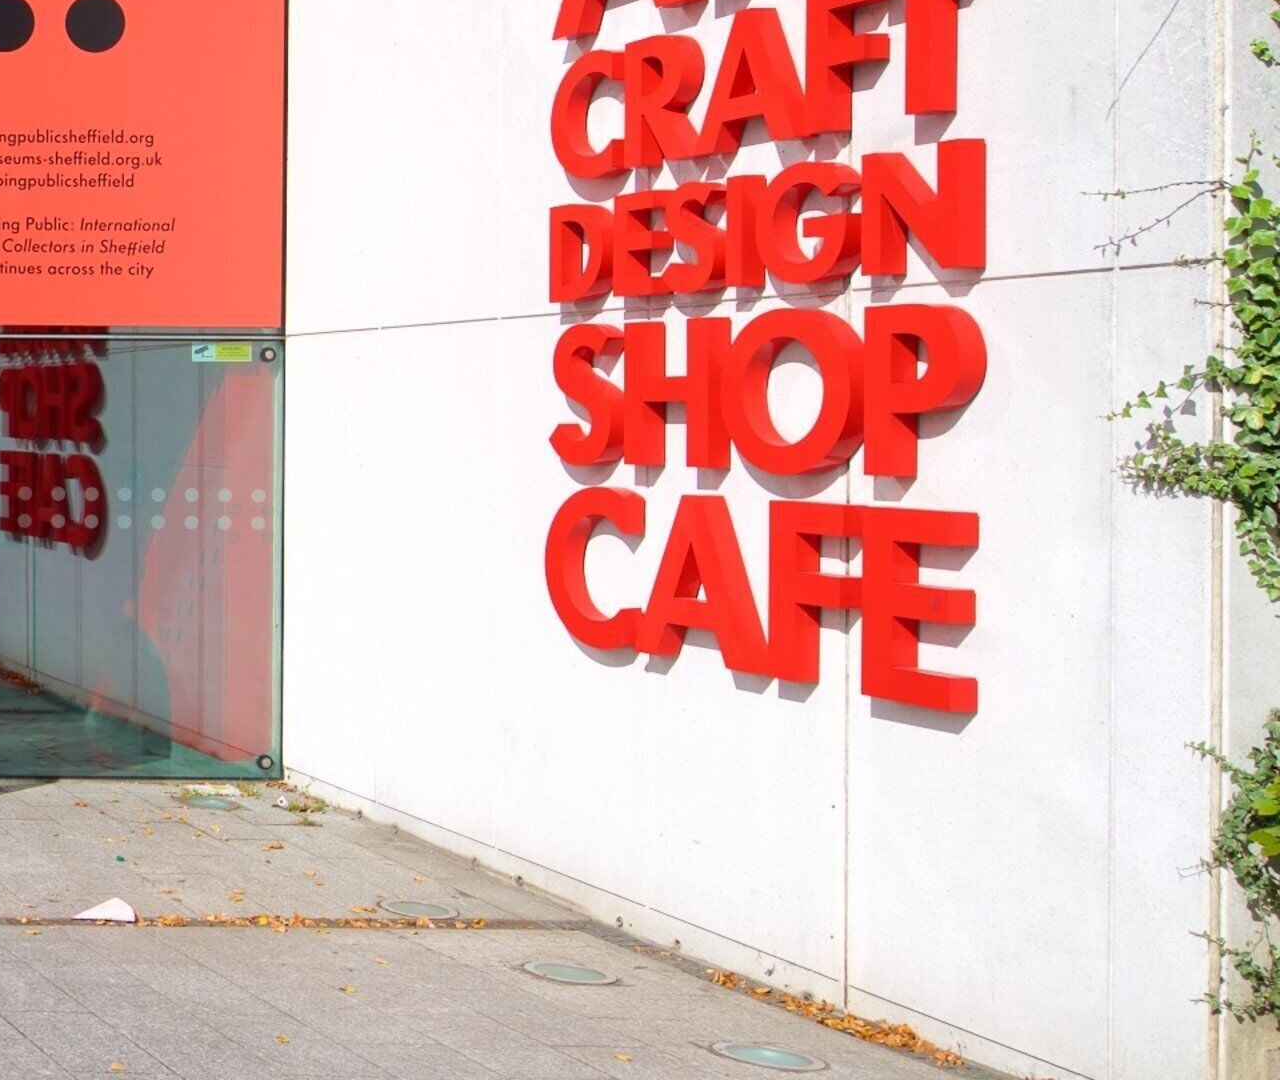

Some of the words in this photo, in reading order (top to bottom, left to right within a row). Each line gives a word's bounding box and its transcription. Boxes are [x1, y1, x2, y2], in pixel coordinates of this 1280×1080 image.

[2, 238, 75, 253] Collectors
[81, 240, 94, 253] in
[99, 239, 166, 256] Sheffield
[26, 217, 75, 231] Public:
[79, 217, 175, 232] International
[549, 138, 986, 303] DESIGN
[47, 265, 95, 275] across
[100, 261, 122, 275] the
[128, 263, 154, 278] city
[549, 303, 987, 477] SHOP
[545, 487, 979, 714] CAFE
